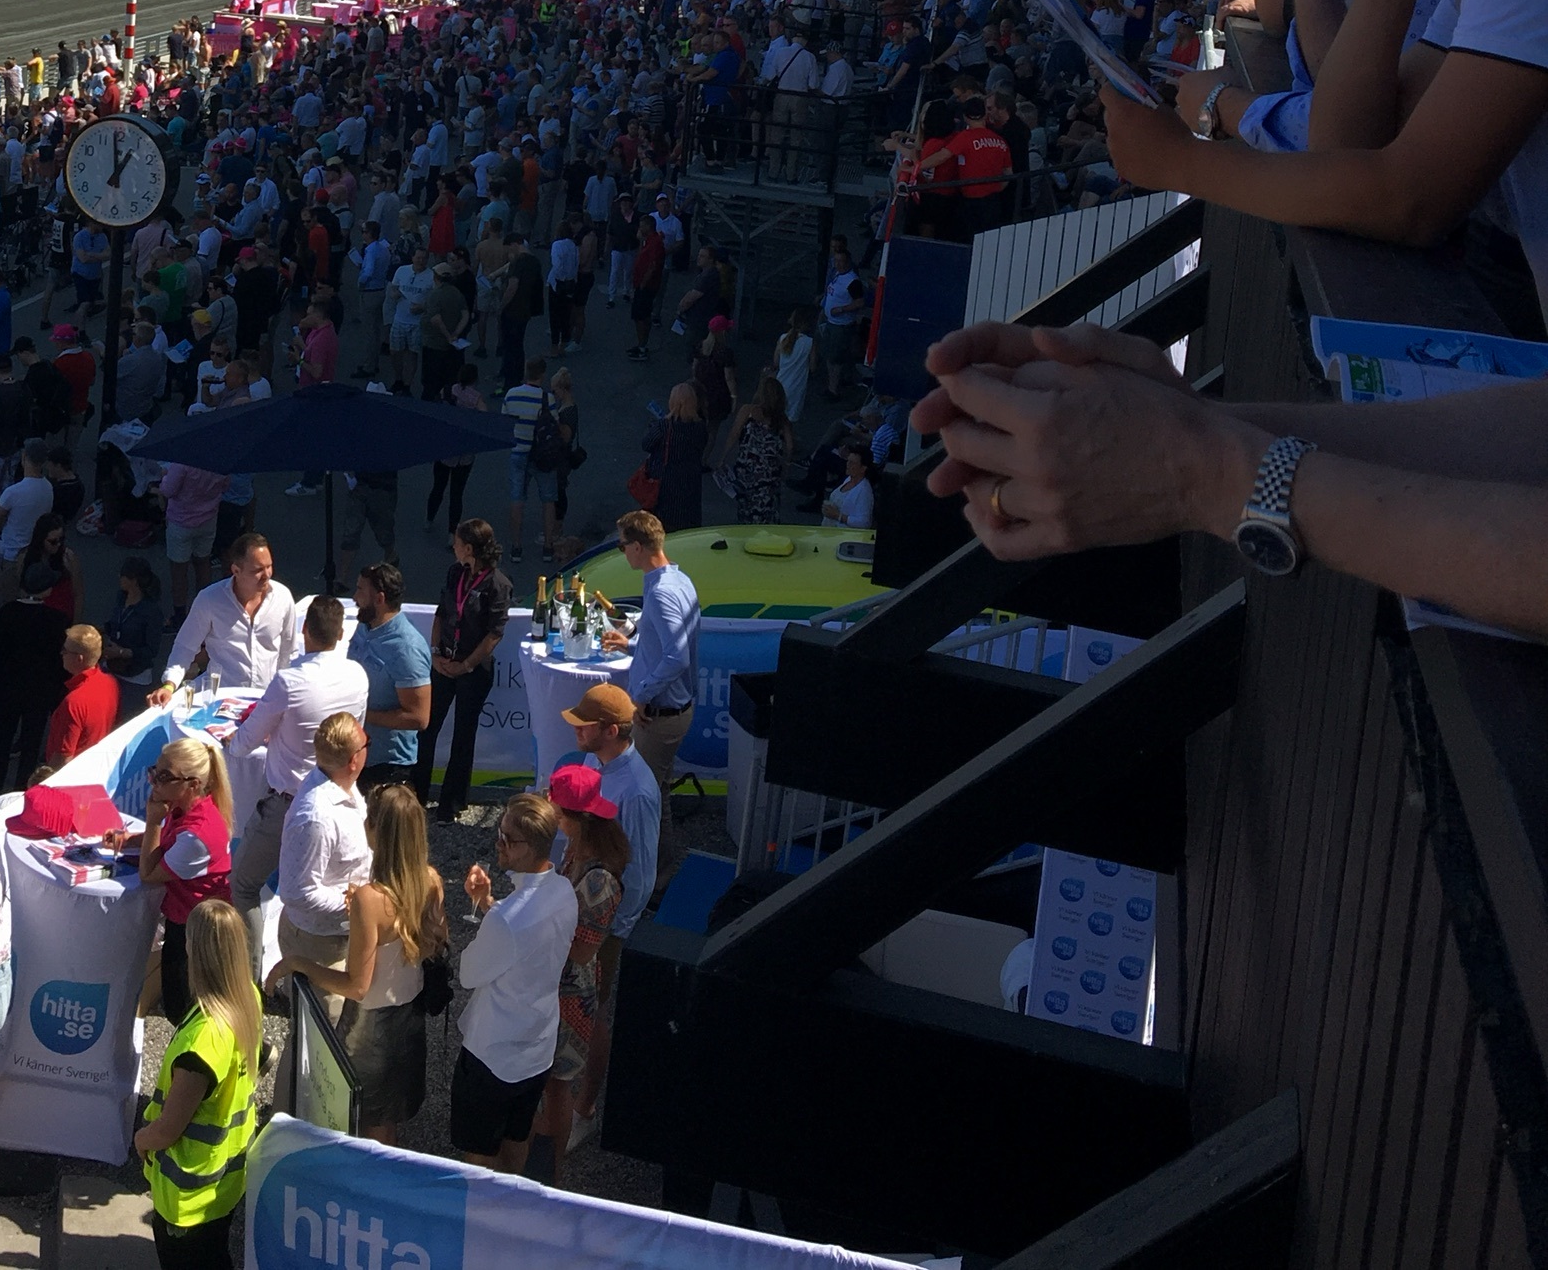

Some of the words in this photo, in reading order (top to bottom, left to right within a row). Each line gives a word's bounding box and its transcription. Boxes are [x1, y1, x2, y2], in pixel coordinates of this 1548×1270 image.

[99, 134, 108, 146] 11
[84, 144, 95, 157] 10
[145, 154, 154, 166] 2
[77, 162, 86, 173] 9
[149, 172, 157, 185] 3
[81, 181, 89, 192] 8
[94, 195, 102, 207] 7
[141, 191, 150, 202] 4
[110, 204, 119, 216] 6
[130, 201, 139, 213] 5
[41, 992, 97, 1023] hitta
[58, 1021, 94, 1040] .se
[13, 1052, 25, 1066] Vi
[27, 1059, 63, 1077] känner
